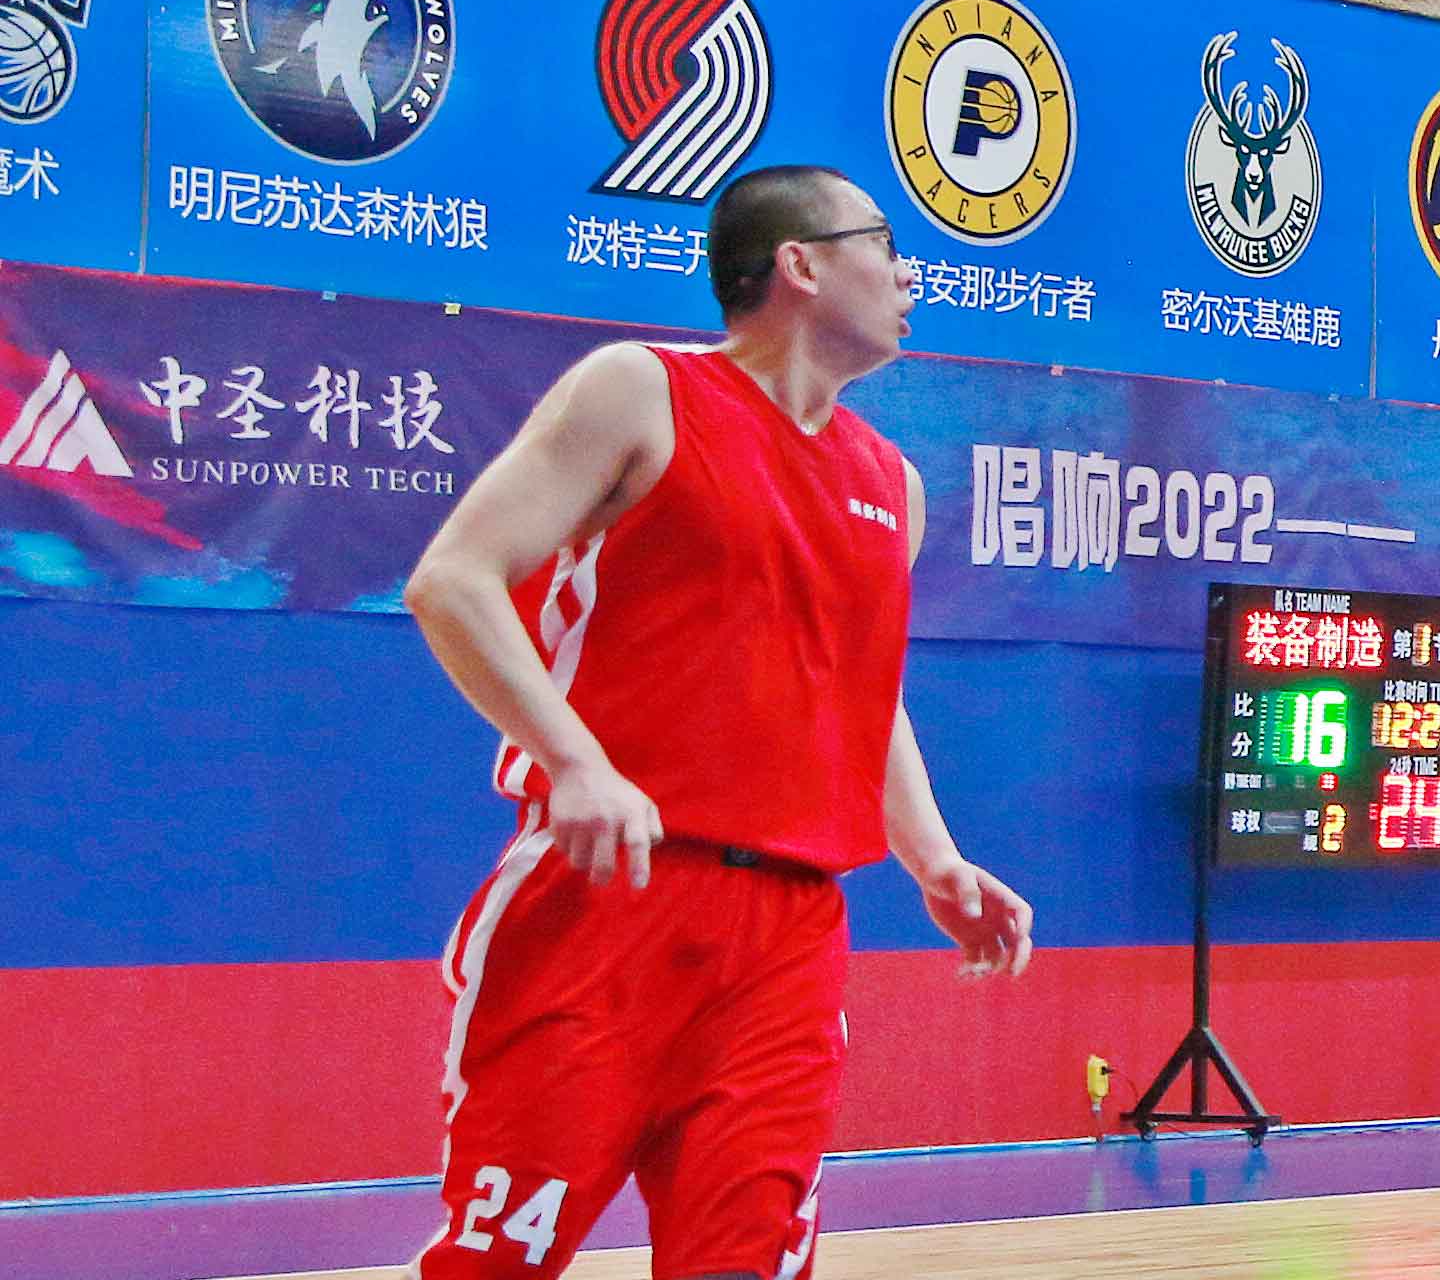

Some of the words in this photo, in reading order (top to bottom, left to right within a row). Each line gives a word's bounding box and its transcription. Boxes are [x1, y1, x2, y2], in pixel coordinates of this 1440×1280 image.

[903, 3, 1059, 104] INDIANA
[168, 165, 489, 250] 明尼苏达森林狼
[906, 147, 1052, 229] PACERS
[1196, 182, 1269, 265] MILWAUKEE
[1271, 196, 1311, 261] BUCKS
[1160, 288, 1341, 348] 密尔沃基雄鹿
[137, 354, 457, 456] 中圣科技
[149, 456, 352, 490] SUNPOWER
[368, 466, 456, 497] TECH
[1245, 611, 1384, 669] 装备制造
[1294, 592, 1322, 613] TEAM
[1322, 593, 1351, 614] NAME
[1290, 690, 1347, 768] 16
[1413, 756, 1439, 776] TIME
[1321, 803, 1347, 853] 2
[455, 1164, 570, 1266] 24
